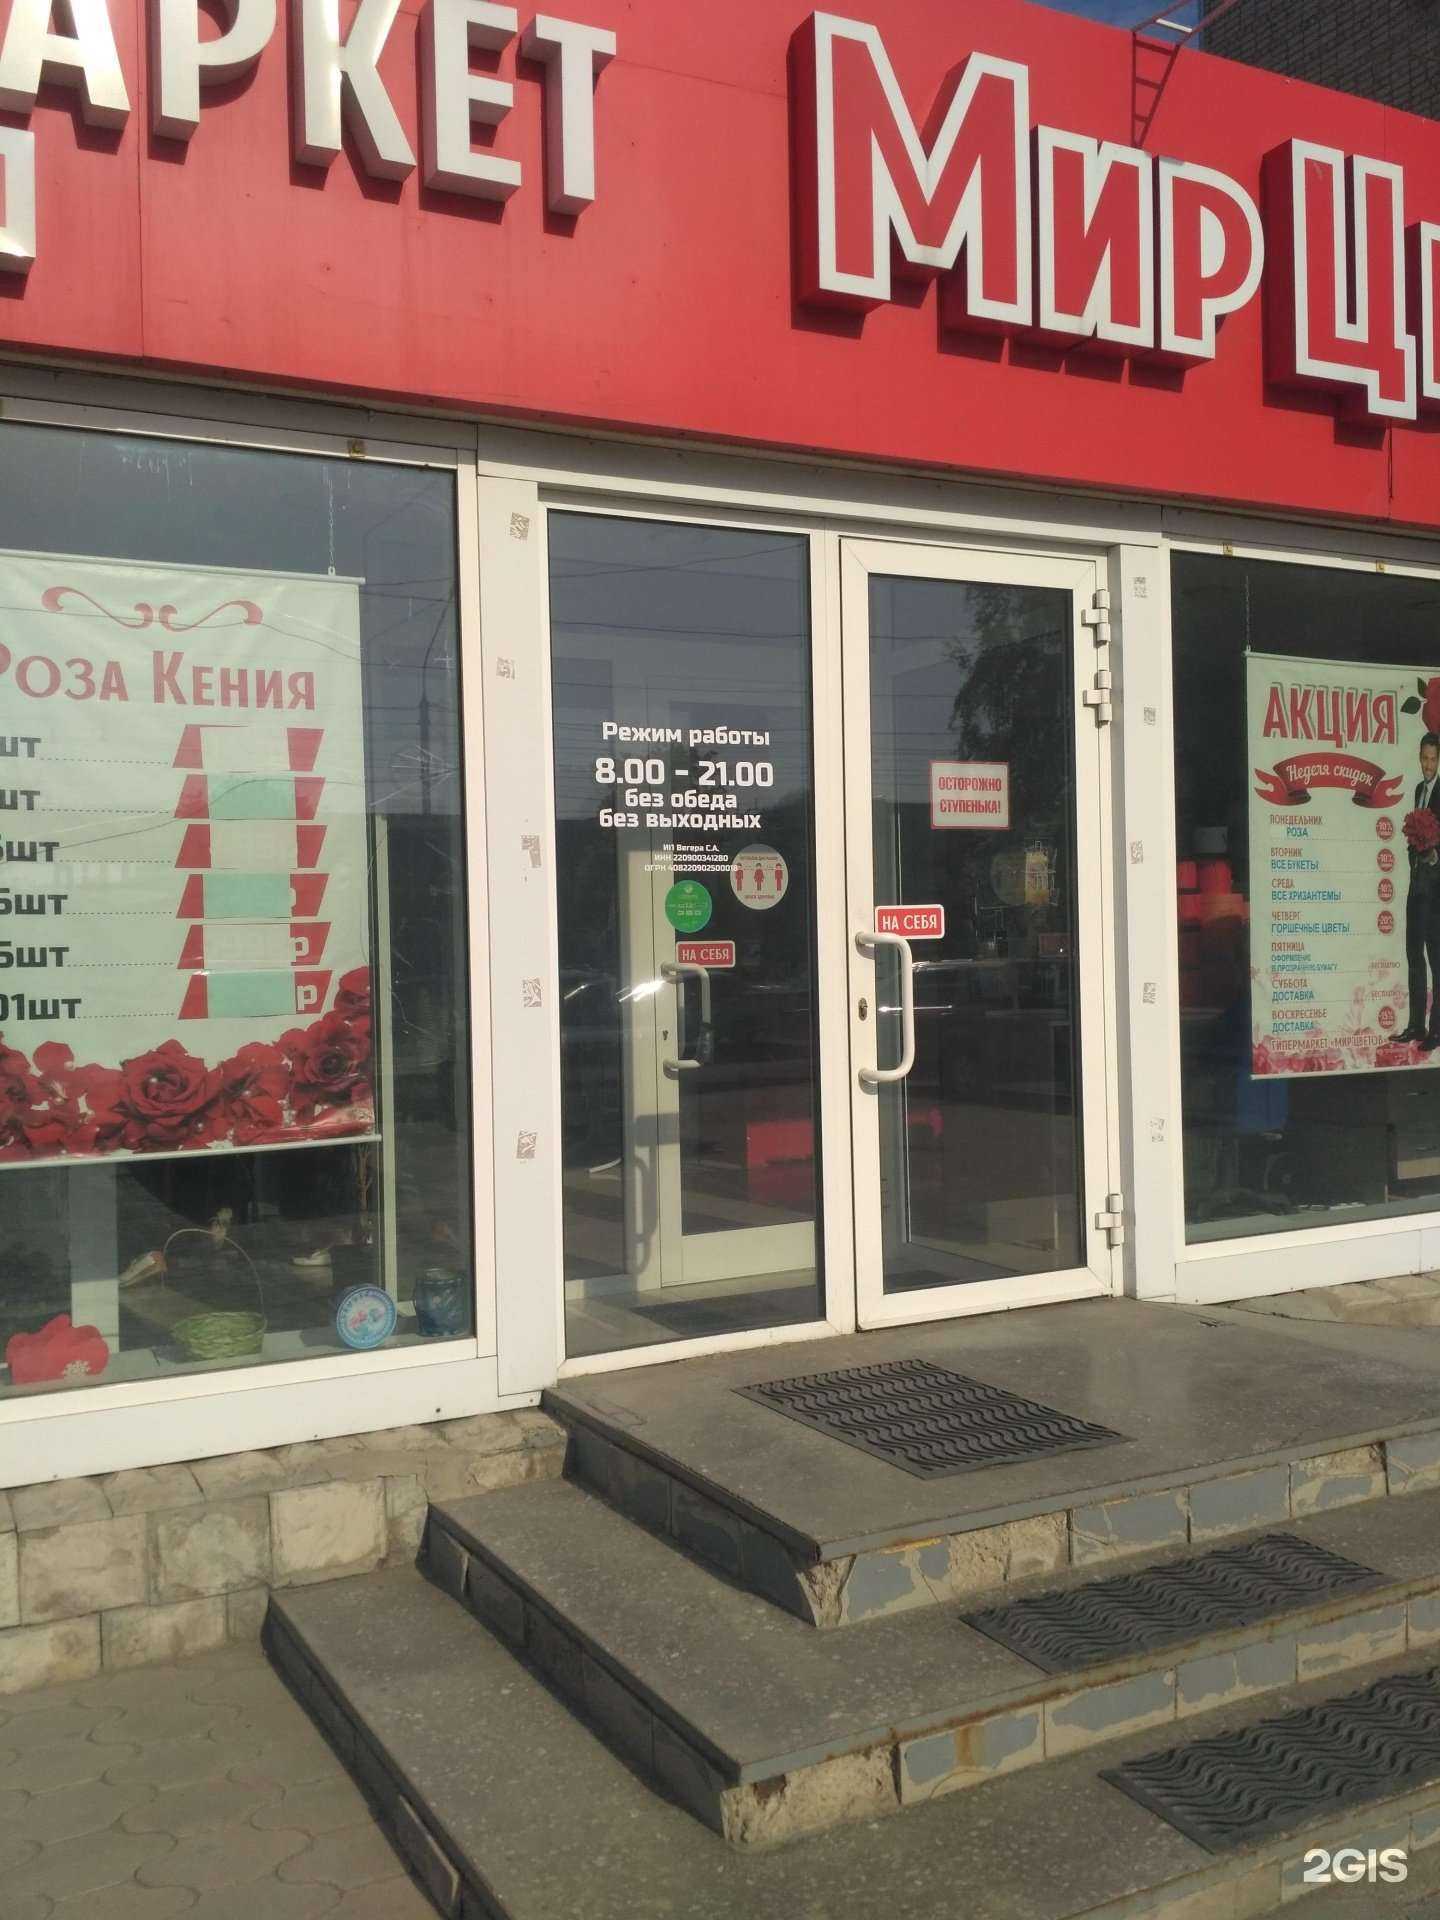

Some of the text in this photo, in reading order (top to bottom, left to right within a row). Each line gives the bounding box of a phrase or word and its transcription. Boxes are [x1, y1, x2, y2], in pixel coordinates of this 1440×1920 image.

[1280, 138, 1440, 420] Ц
[1262, 682, 1399, 748] АКЦИЯ
[602, 721, 770, 747] Режим работы
[595, 757, 665, 785] 8.00
[698, 760, 774, 787] 21.00
[938, 776, 1002, 792] ОСТОРОЖНО
[625, 788, 738, 811] без обеда
[939, 799, 1001, 814] СТУПЕНЬКА!
[600, 808, 761, 831] без выходных
[1270, 814, 1323, 825] ПОНЕДЕЛЬНИК
[1286, 827, 1308, 838] РОЗА
[0, 835, 60, 863] шт
[663, 844, 675, 852] ИП
[1270, 847, 1303, 858] ВТОРНИК
[1271, 859, 1287, 870] ВСЕ
[1271, 878, 1295, 889] СРЕДА
[1271, 890, 1288, 901] ВСЕ
[882, 914, 937, 930] НА СЕБЯ
[1271, 911, 1301, 921] ЧЕТВЕРГ
[682, 949, 729, 961] НА СЕБЯ
[1271, 978, 1308, 989] СУББОТА
[1272, 990, 1314, 1002] ДОСТАВКА
[1271, 1008, 1328, 1020] ВОСКРЕСЕНЬЕ
[1272, 1022, 1314, 1034] ДОСТАВКА
